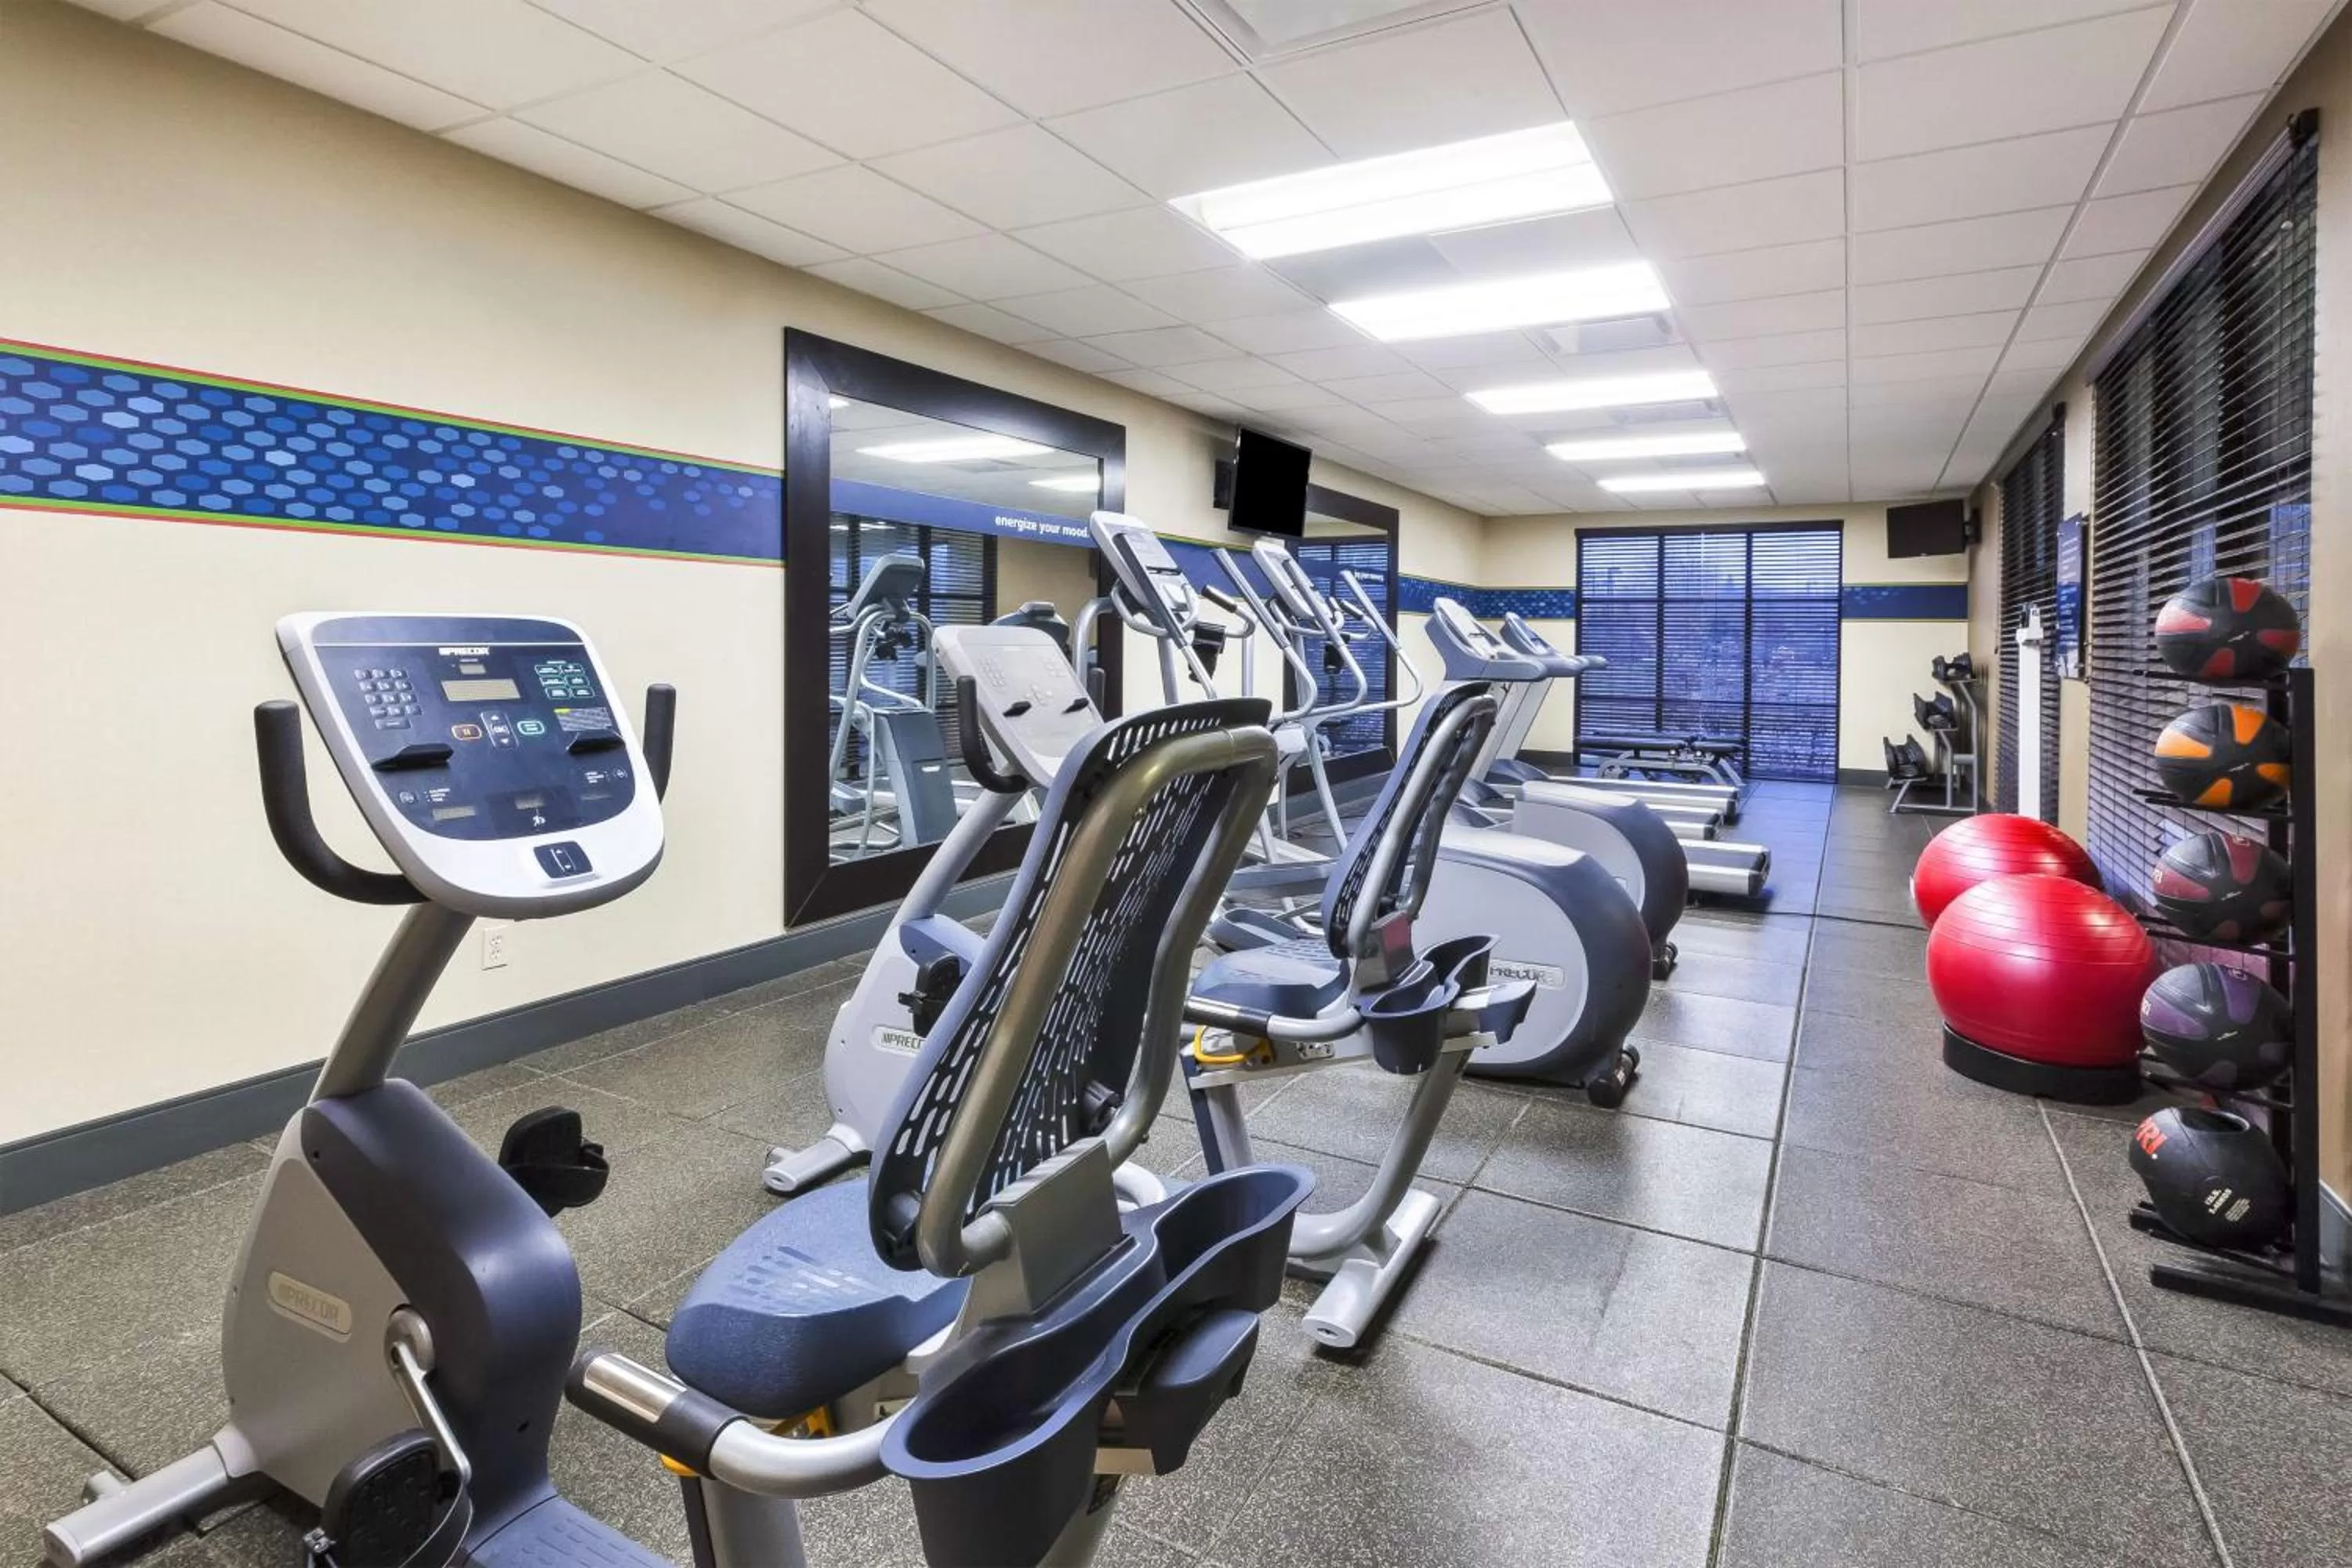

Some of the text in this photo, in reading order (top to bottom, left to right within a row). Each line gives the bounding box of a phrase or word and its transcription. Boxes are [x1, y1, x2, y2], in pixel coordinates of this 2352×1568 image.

[994, 515, 1037, 532] energize
[1039, 521, 1060, 534] your
[890, 1033, 921, 1049] PREC
